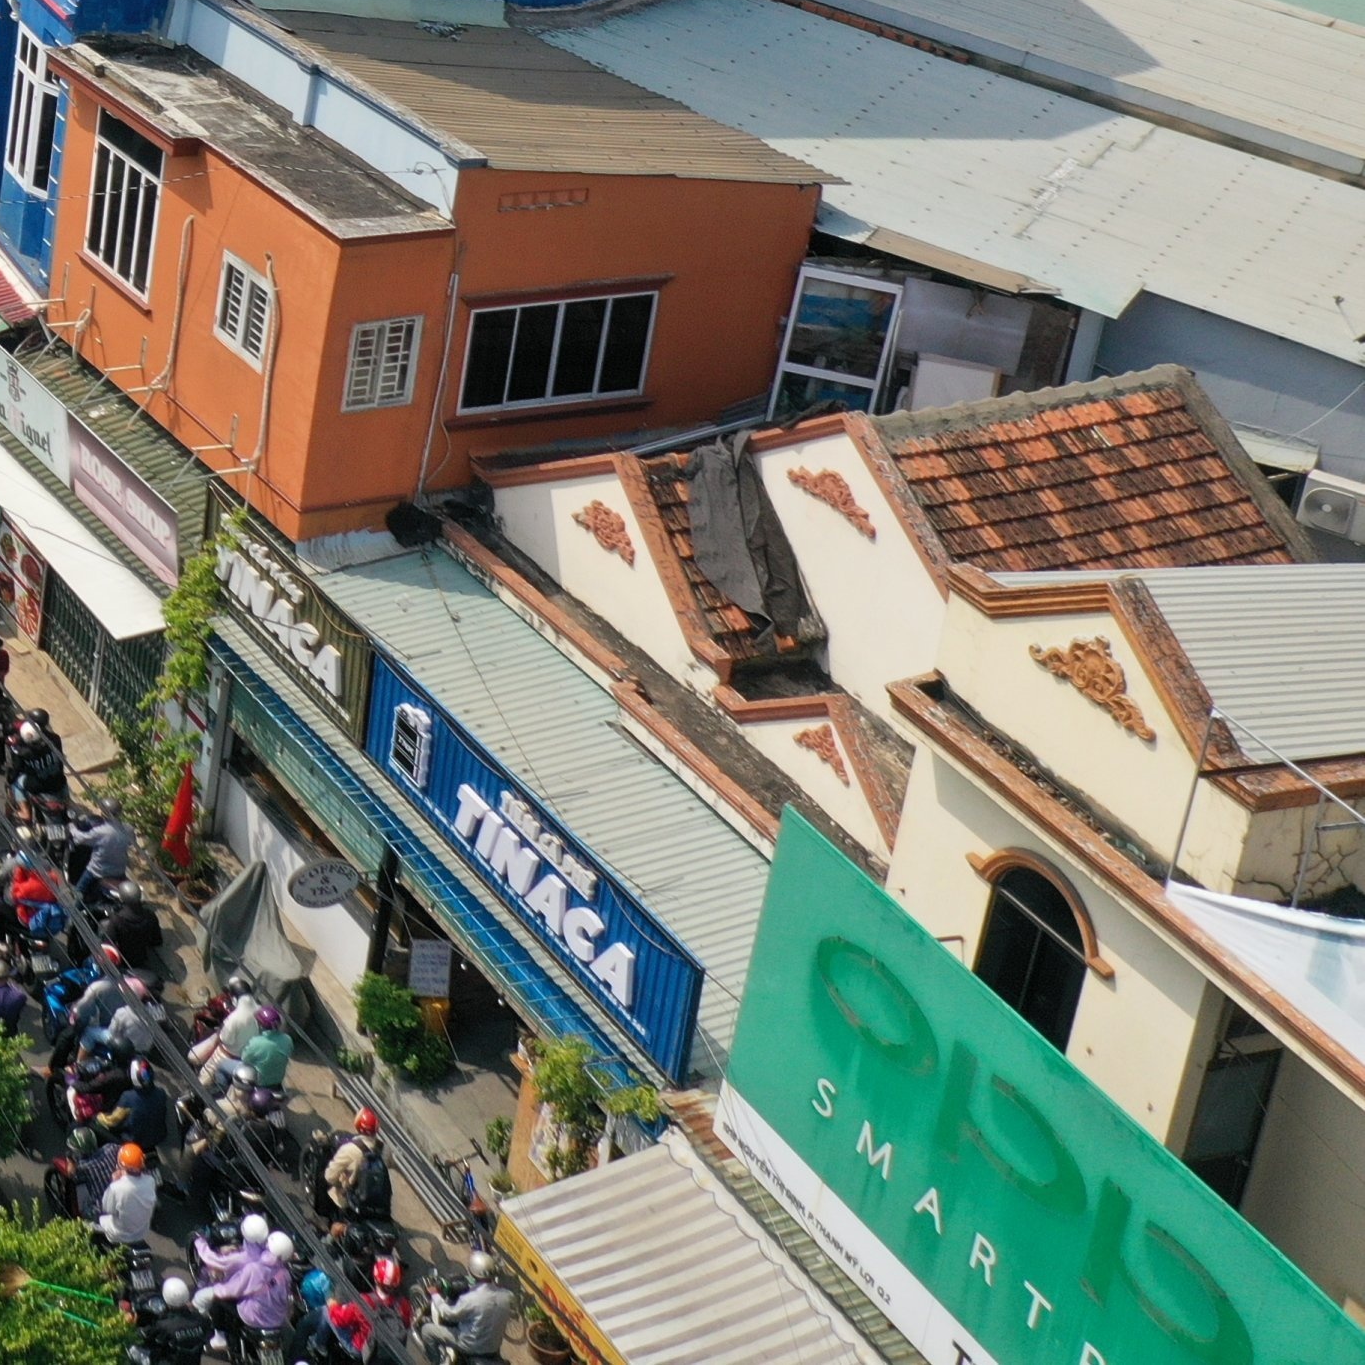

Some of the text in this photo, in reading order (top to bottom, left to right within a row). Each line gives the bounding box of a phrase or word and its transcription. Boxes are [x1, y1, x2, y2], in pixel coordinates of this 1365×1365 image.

[79, 441, 124, 508] ROSE
[297, 862, 356, 885] COFFEE
[454, 783, 635, 1007] TINACA
[811, 1077, 1053, 1332] SMART
